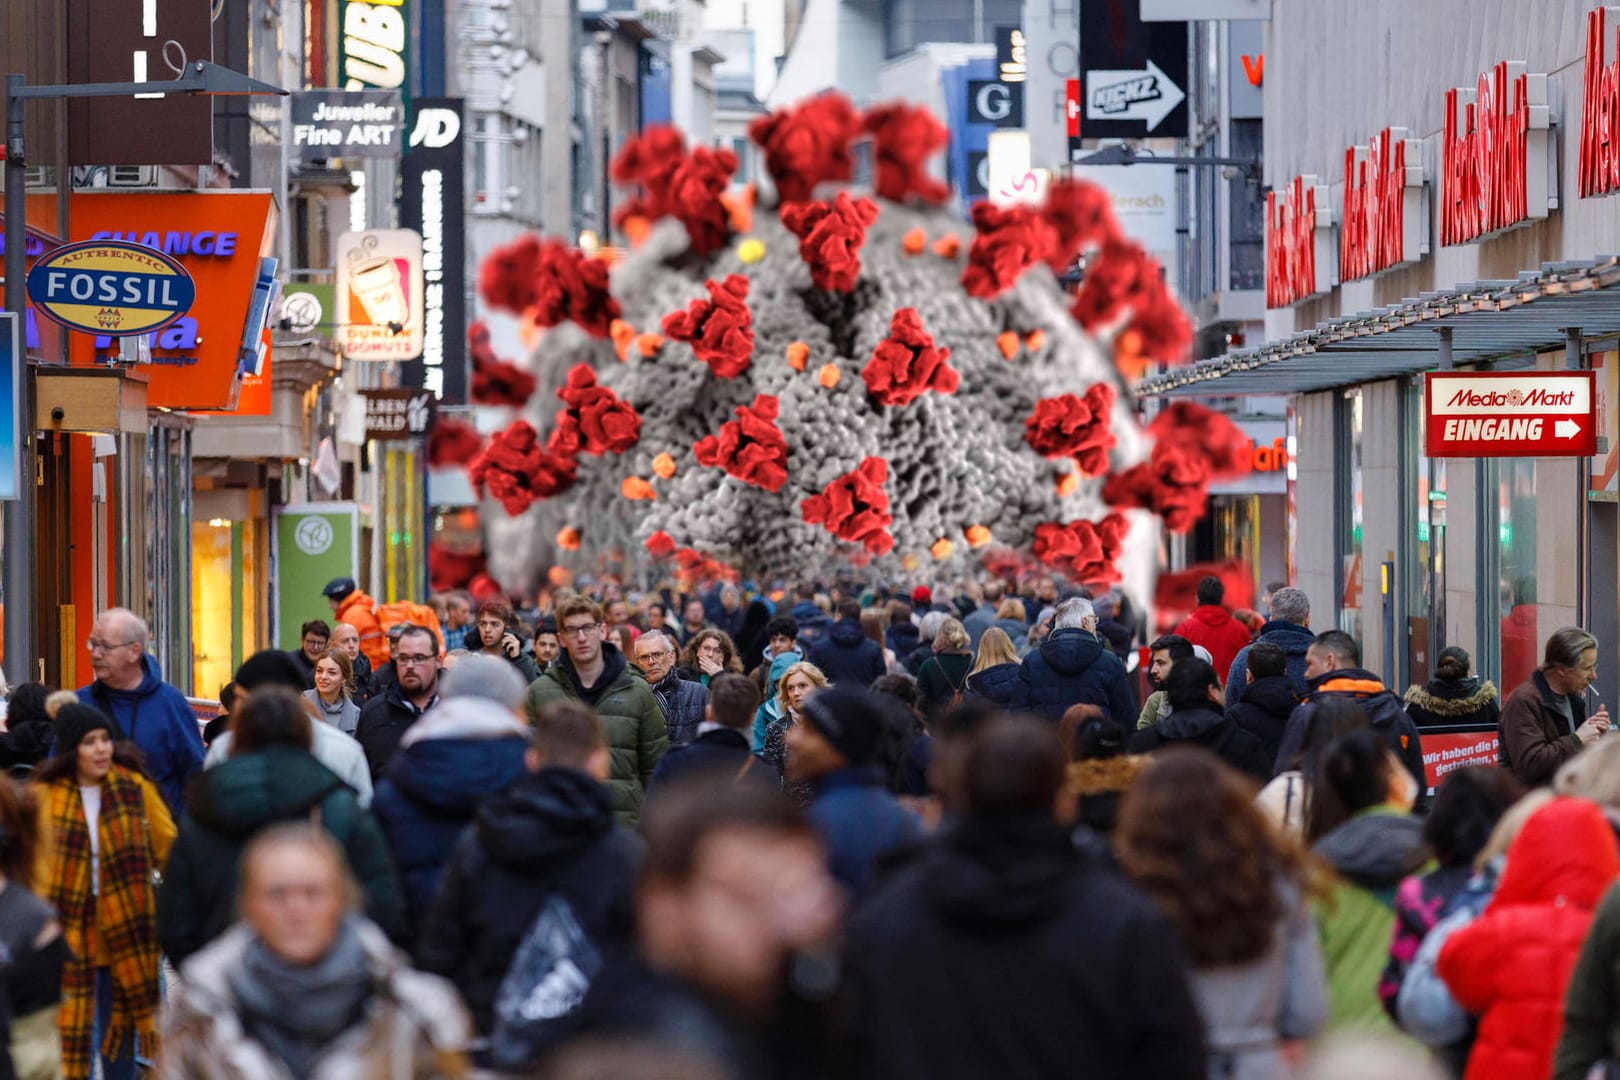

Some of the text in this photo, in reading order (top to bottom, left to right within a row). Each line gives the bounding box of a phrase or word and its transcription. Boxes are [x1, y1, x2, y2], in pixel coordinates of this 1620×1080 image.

[976, 83, 1012, 120] G
[294, 124, 342, 145] Fine
[346, 124, 394, 145] ART
[409, 108, 460, 148] JD
[62, 249, 165, 272] AUTHENTIC
[47, 272, 178, 306] FOSSIL
[1447, 388, 1575, 407] Media Markt
[1443, 418, 1544, 441] EINGANG
[1422, 738, 1499, 765] Wir haben die P
